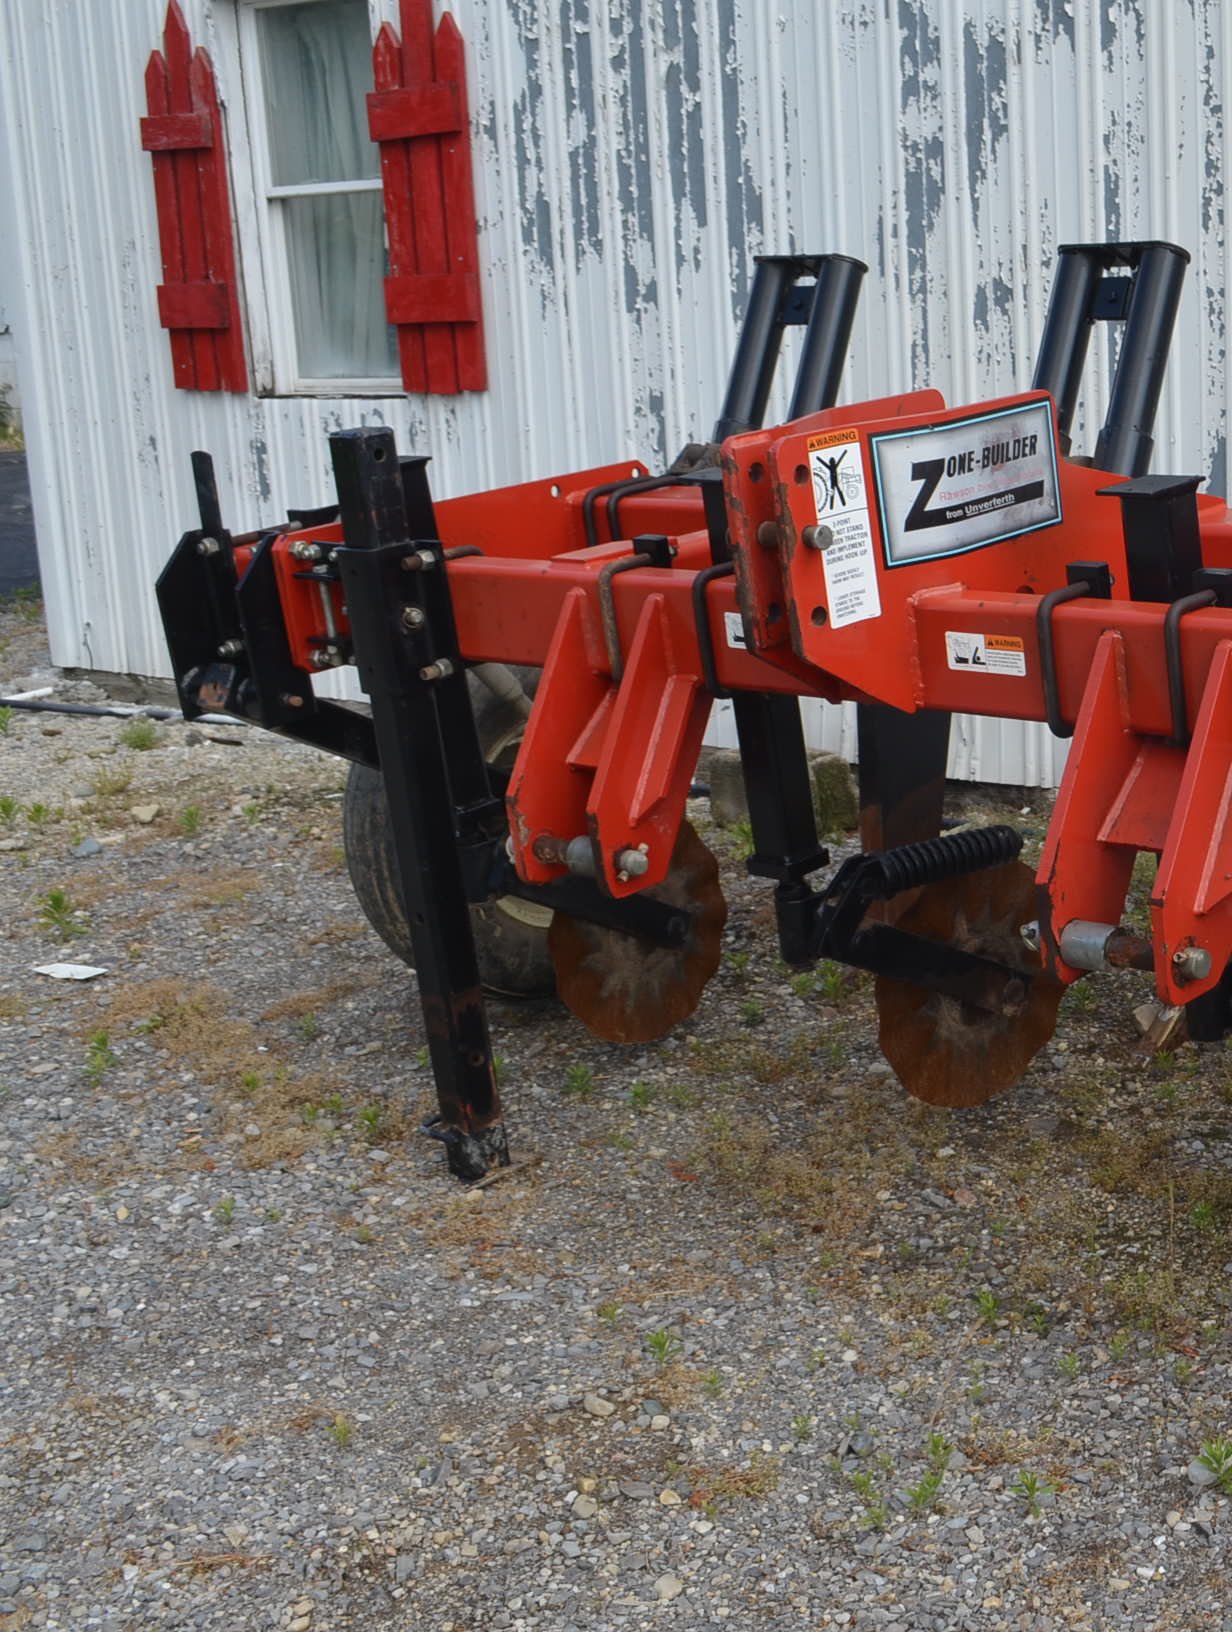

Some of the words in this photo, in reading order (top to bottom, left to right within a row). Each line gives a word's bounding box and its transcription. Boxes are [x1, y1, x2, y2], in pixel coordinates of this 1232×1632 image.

[815, 431, 857, 446] WARNING
[946, 508, 964, 520] from
[965, 493, 1016, 516] Unverferth
